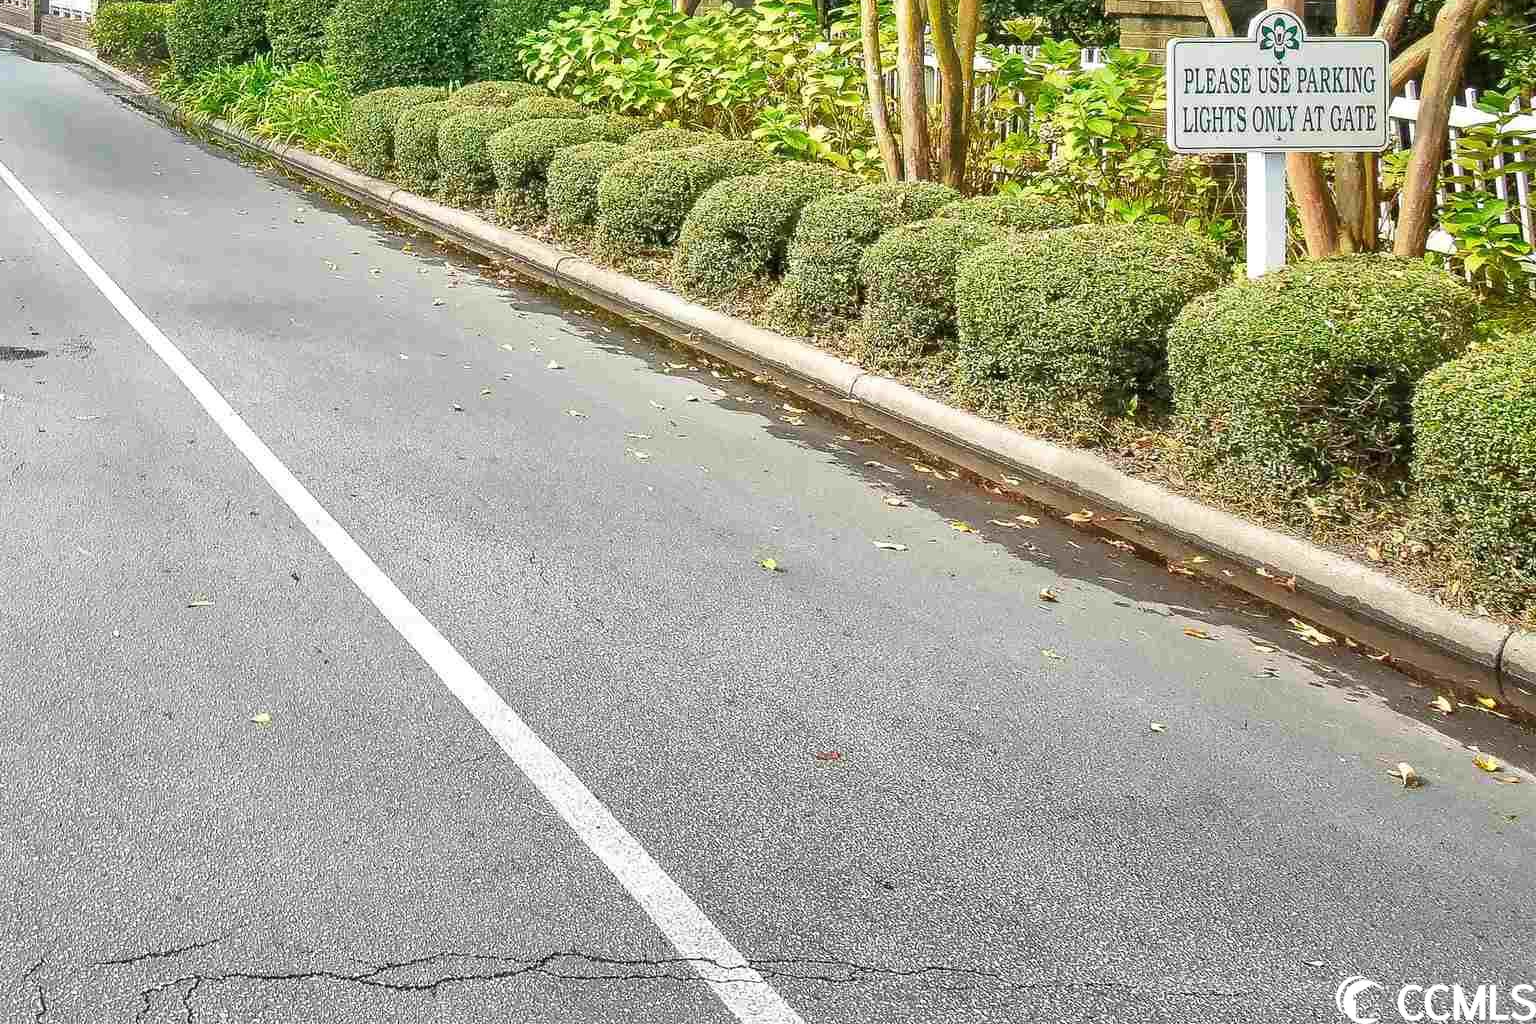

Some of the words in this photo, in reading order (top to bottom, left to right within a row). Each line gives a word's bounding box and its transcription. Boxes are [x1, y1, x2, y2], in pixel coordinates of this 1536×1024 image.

[1183, 67, 1251, 94] PLEASE
[1258, 67, 1290, 94] USE
[1296, 66, 1376, 94] PARKING
[1183, 106, 1247, 133] LIGHTS
[1253, 106, 1297, 132] ONLY
[1303, 105, 1326, 131] AT
[1330, 105, 1376, 131] GATE
